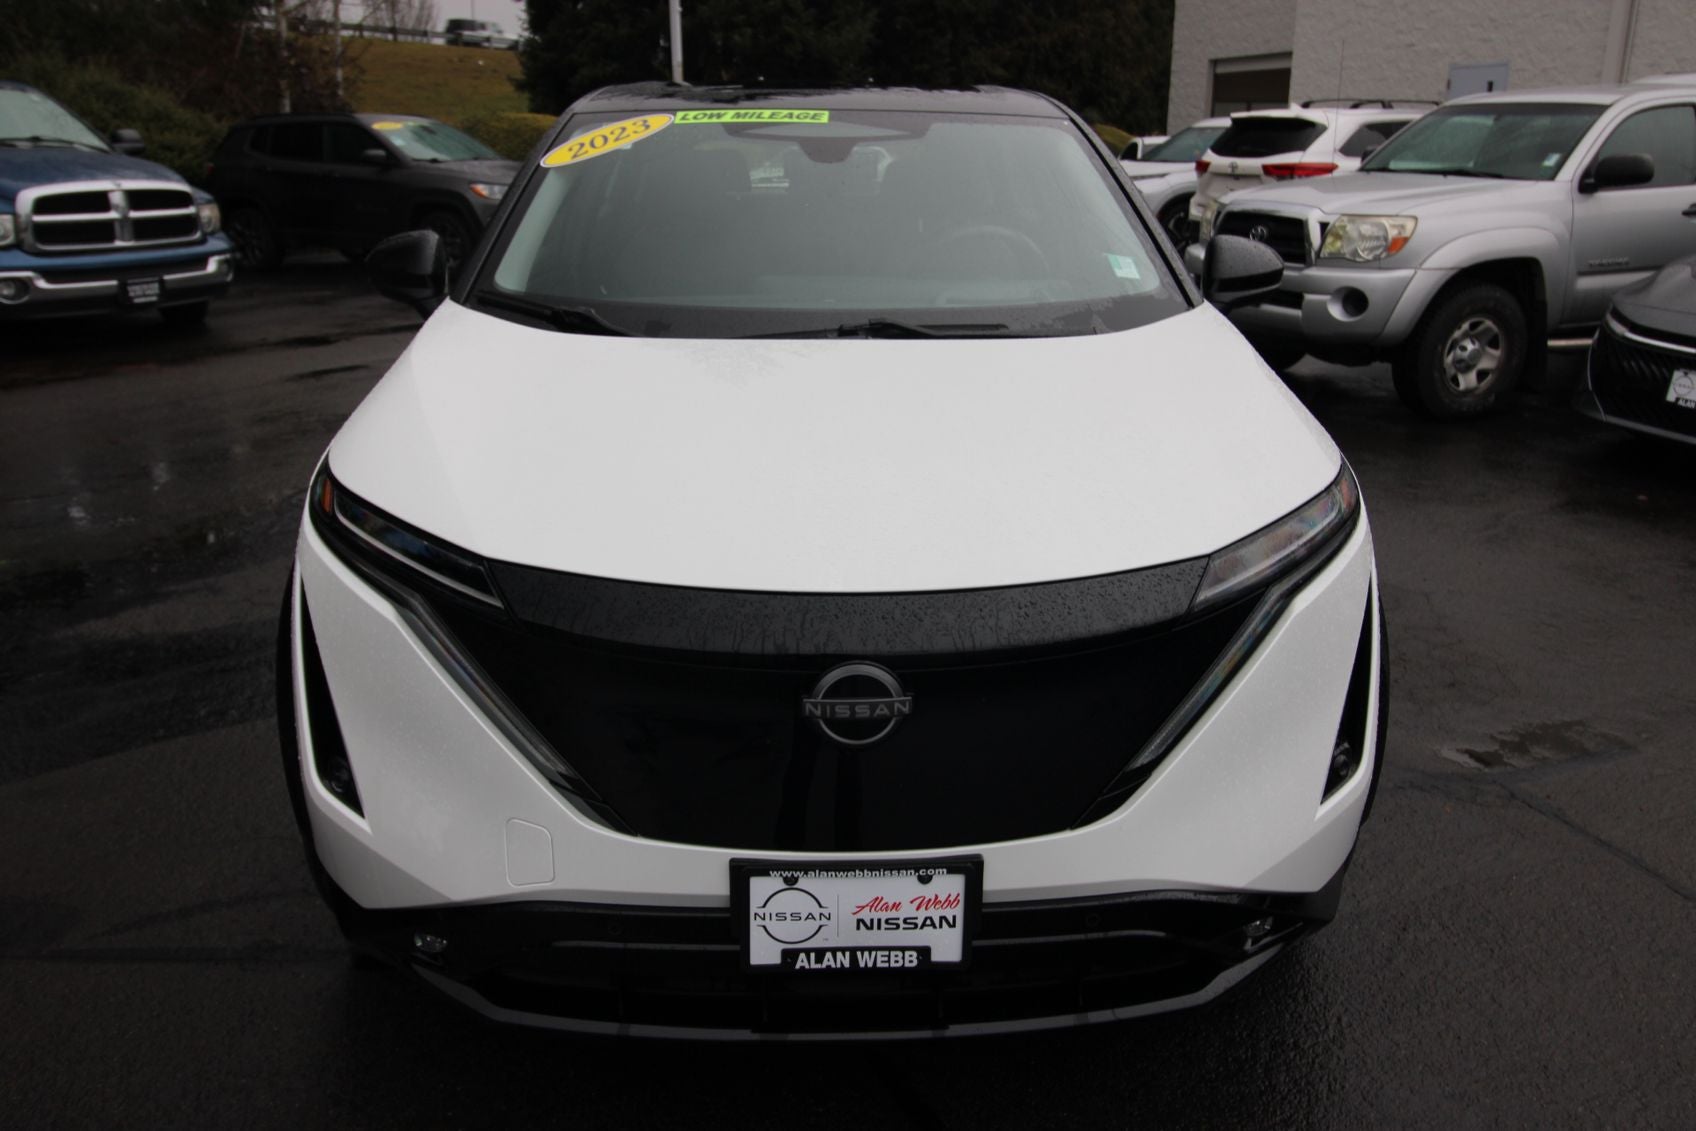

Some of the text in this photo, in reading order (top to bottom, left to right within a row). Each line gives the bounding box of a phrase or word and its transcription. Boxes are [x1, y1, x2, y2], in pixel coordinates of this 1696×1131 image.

[679, 111, 826, 121] LOW MILEAGE
[567, 119, 650, 160] 2023
[804, 701, 910, 718] NISSAN
[769, 867, 948, 879] www.alanwebbnissan.com
[852, 892, 961, 916] Alan Webb
[753, 911, 832, 922] NISSAN
[855, 914, 957, 932] NISSAN
[795, 950, 918, 970] ALAN WEBB
